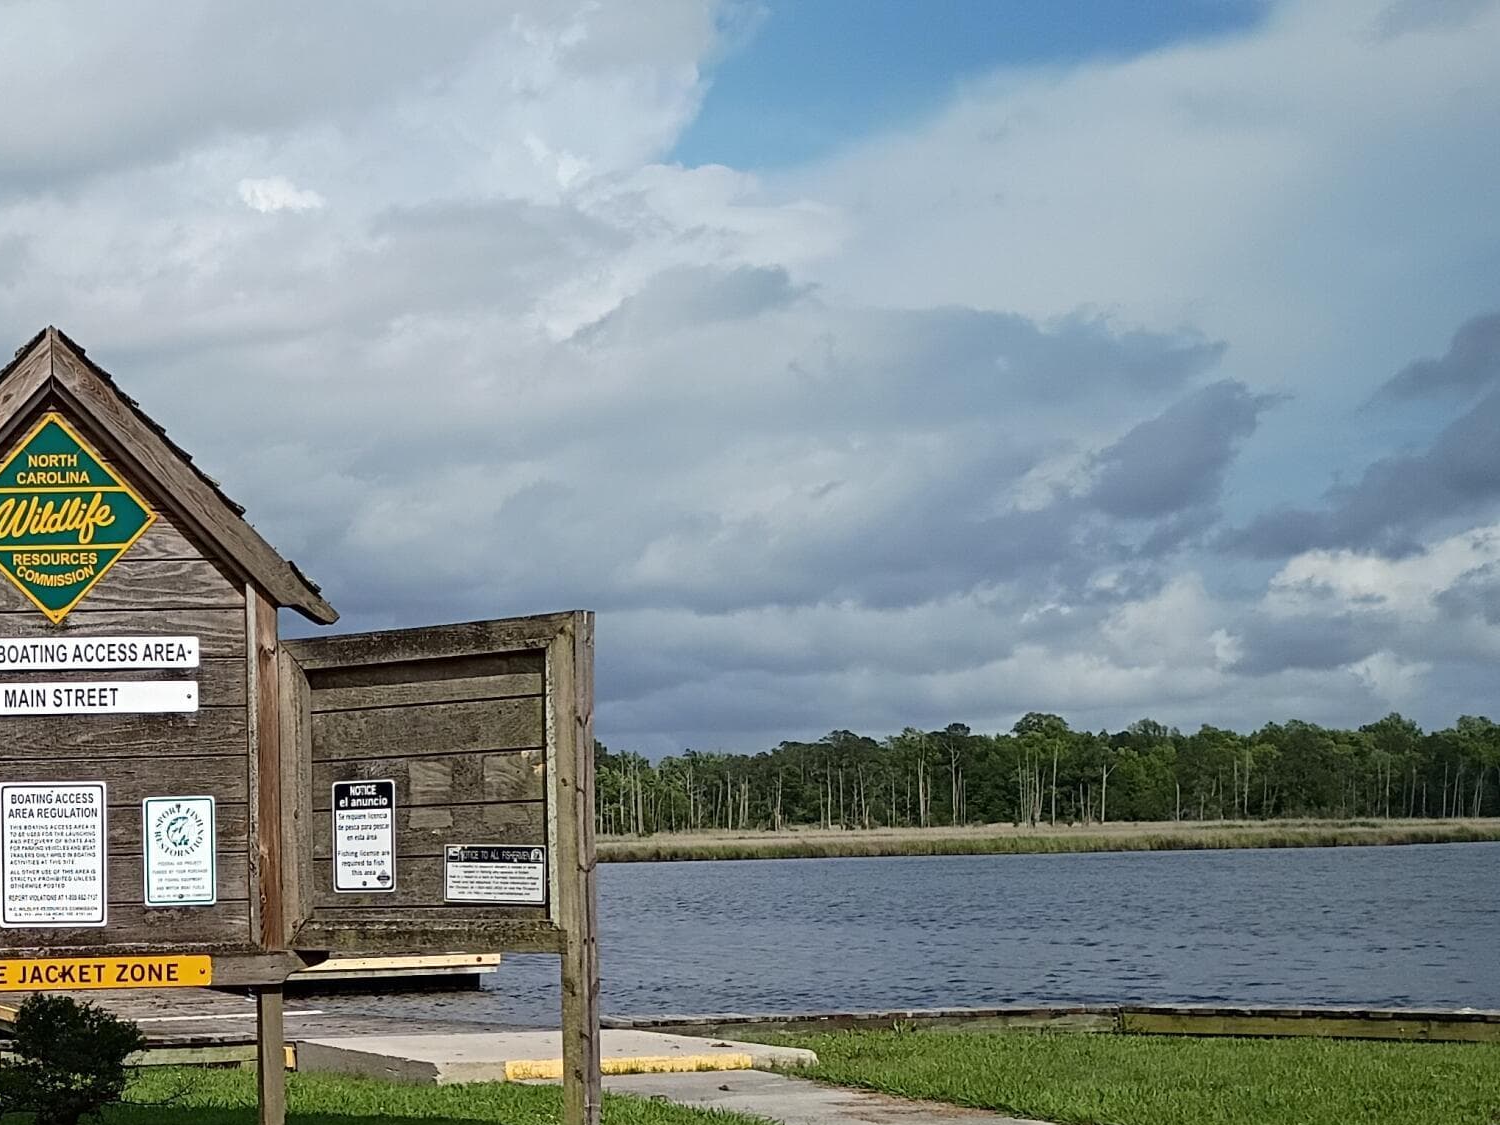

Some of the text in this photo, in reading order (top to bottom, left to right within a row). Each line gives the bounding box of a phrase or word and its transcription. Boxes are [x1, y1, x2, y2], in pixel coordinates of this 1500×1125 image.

[28, 455, 77, 467] NORTH
[16, 471, 90, 484] CAROLINA
[13, 552, 97, 566] RESOURCES
[16, 565, 94, 586] COMMISSION
[72, 644, 138, 662] ACCESS
[142, 643, 186, 662] AREA
[4, 689, 46, 708] MAIN
[53, 688, 118, 707] STREET
[350, 785, 376, 796] NOTICE
[11, 793, 94, 804] BOATING ACCESS
[339, 796, 387, 807] el anuncio
[8, 808, 98, 818] AREA REGULATION
[18, 964, 106, 984] JACKET
[116, 963, 179, 982] ZONE
